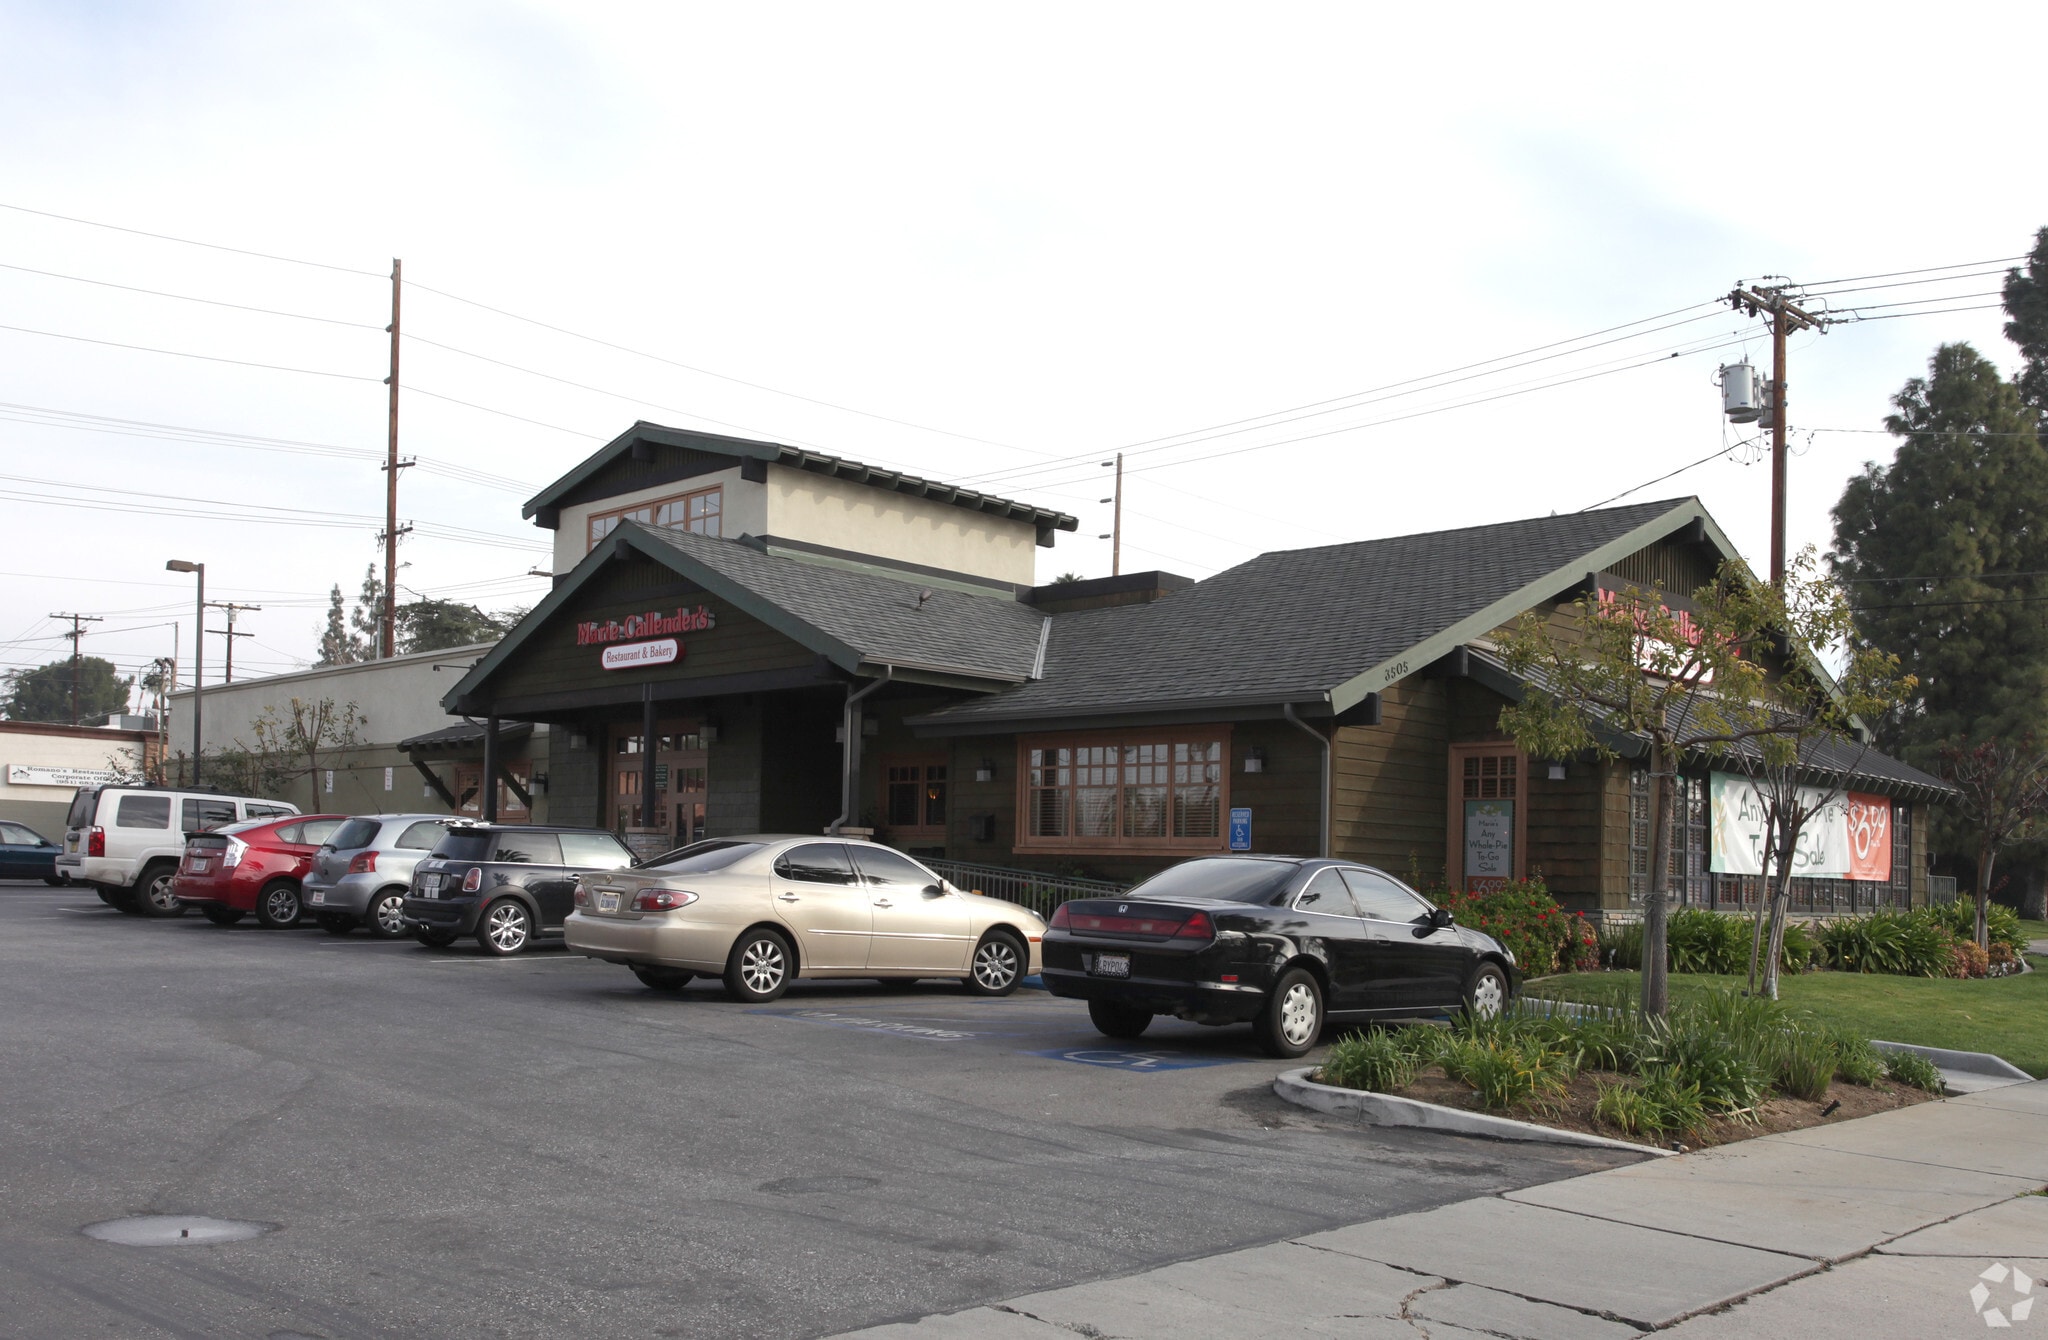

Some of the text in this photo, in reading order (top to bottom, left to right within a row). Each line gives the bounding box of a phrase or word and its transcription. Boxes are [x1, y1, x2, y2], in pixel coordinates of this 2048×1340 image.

[577, 606, 710, 645] Marie Callender's
[606, 645, 674, 663] Restaurant & Bakery
[1384, 661, 1409, 681] 3505
[27, 766, 67, 774] Romano's
[1478, 819, 1499, 827] Marie's
[1481, 829, 1496, 839] Any
[1469, 840, 1508, 850] Whole-Pie
[1793, 832, 1826, 868] Sale
[1476, 851, 1500, 861] To-Go
[1478, 861, 1497, 872] Sale
